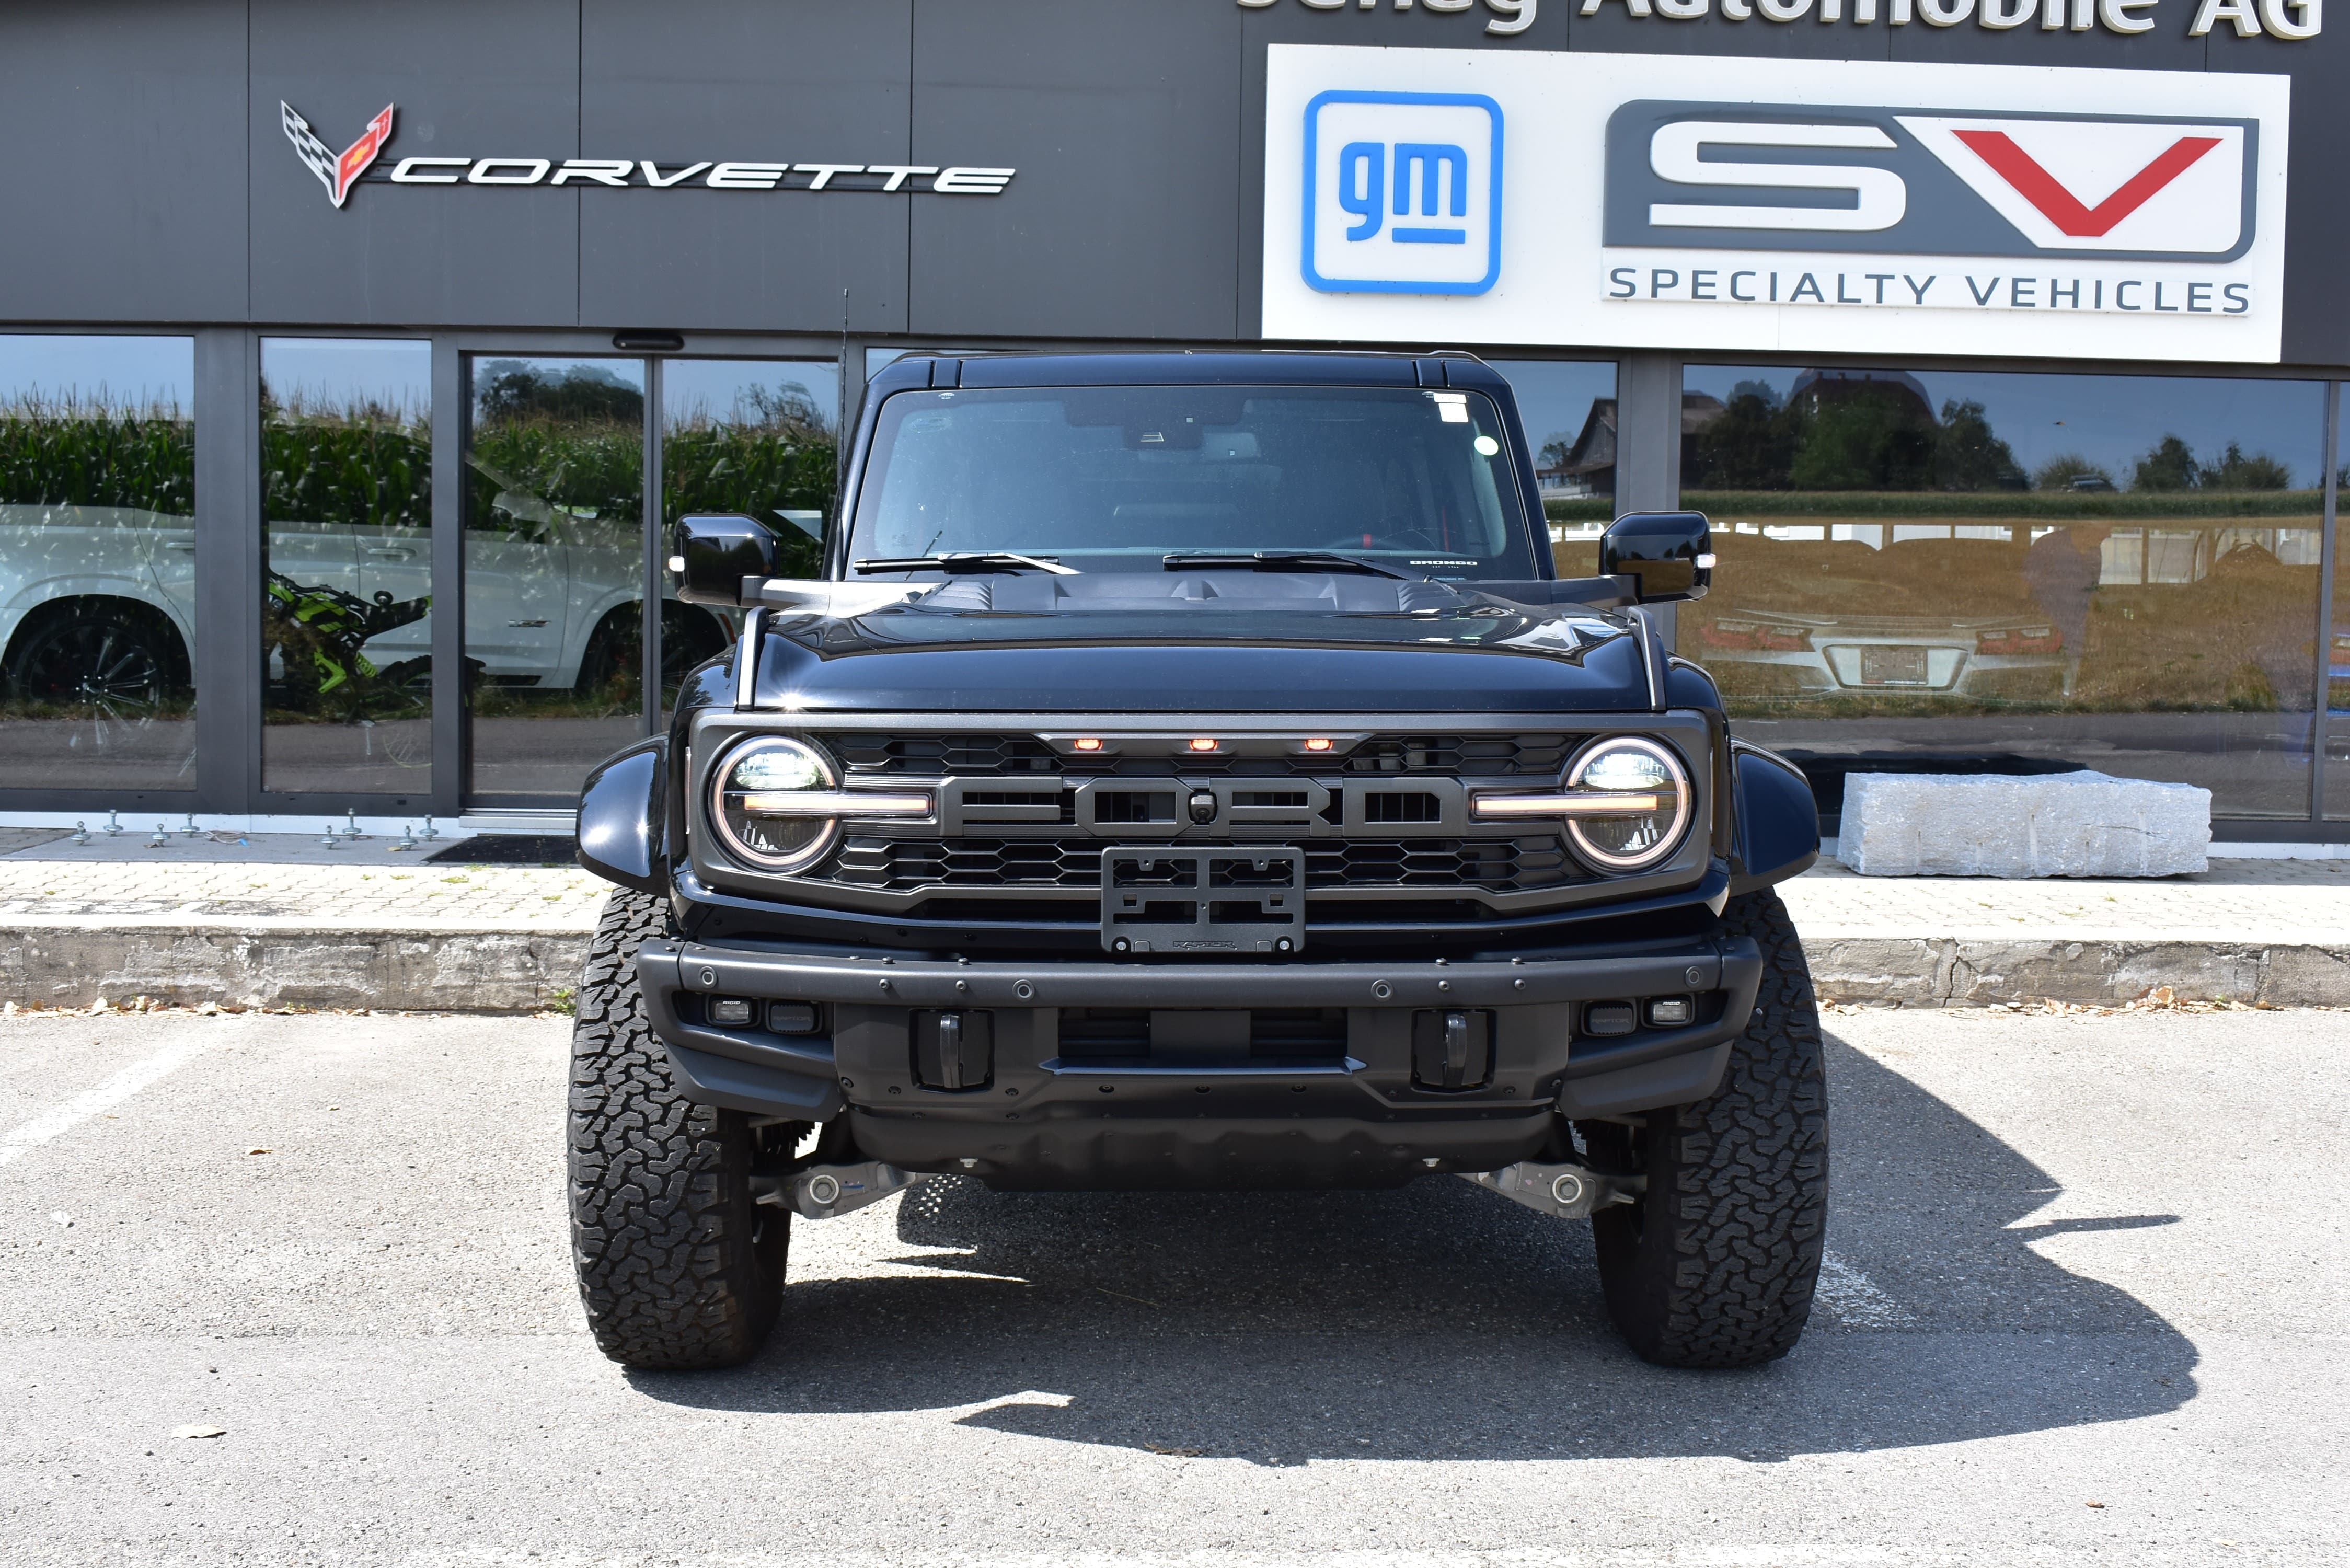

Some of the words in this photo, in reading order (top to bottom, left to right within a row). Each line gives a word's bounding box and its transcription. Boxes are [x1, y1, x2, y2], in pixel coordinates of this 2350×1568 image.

[391, 157, 1016, 193] CORVETTE
[1339, 142, 1467, 242] gm
[1609, 268, 1937, 305] SPECIALTY
[1965, 275, 2249, 313] VEHICLES
[940, 777, 1464, 836] FORD
[1173, 941, 1237, 950] RAPTOR
